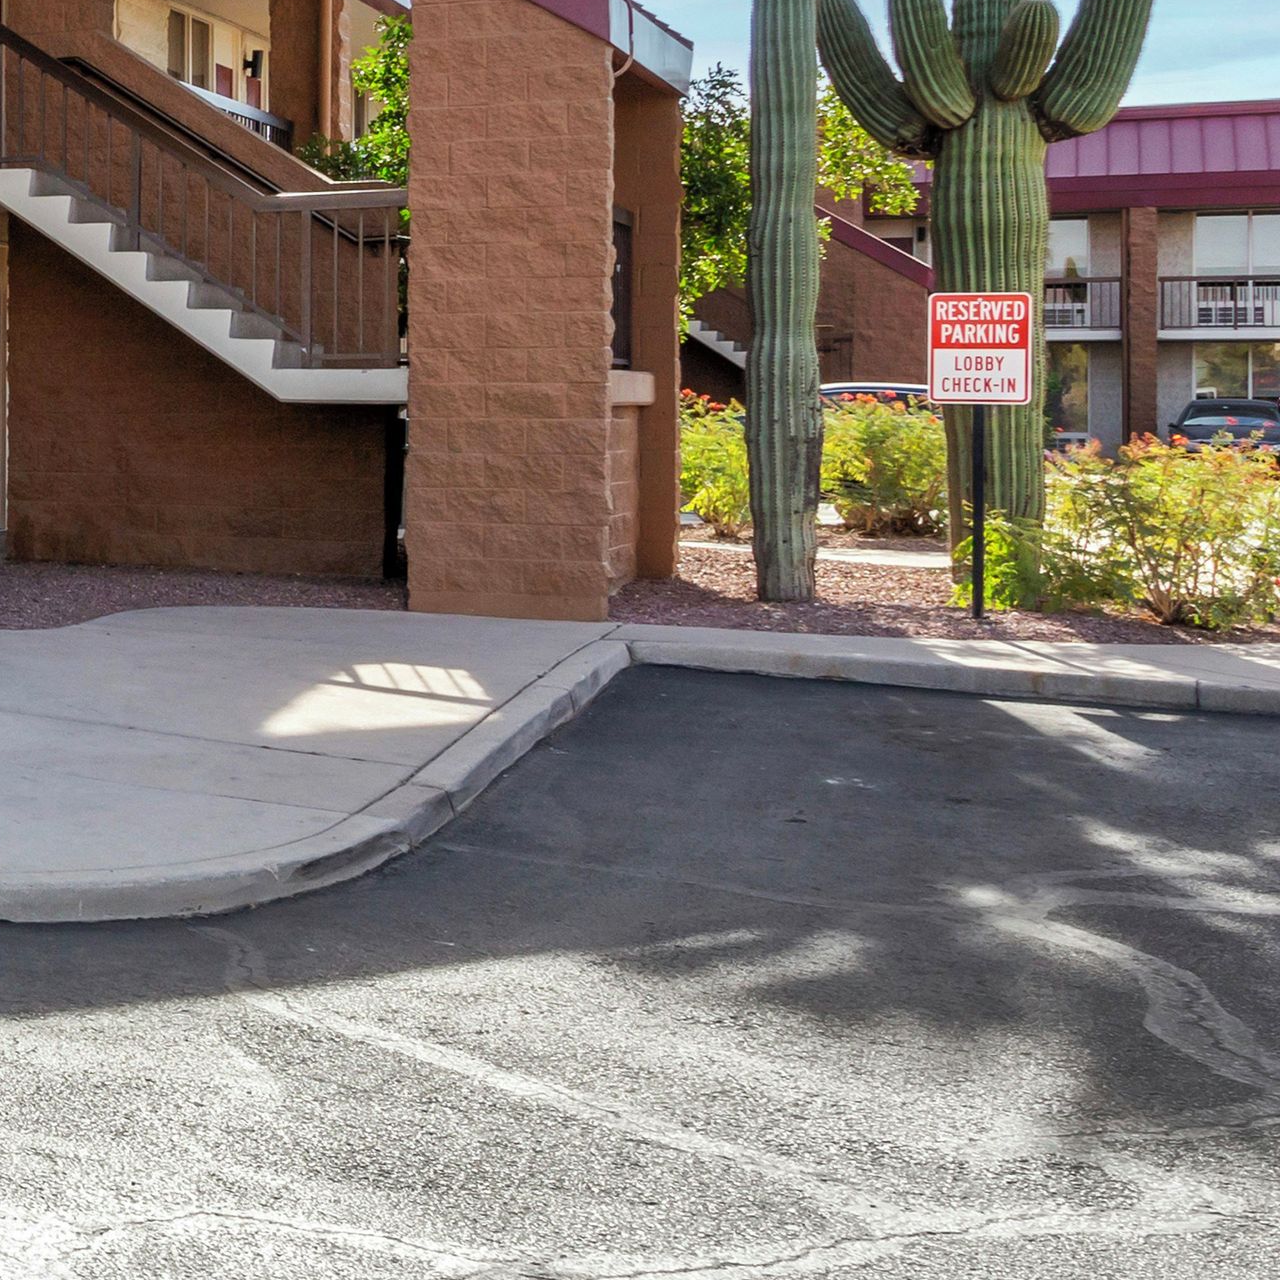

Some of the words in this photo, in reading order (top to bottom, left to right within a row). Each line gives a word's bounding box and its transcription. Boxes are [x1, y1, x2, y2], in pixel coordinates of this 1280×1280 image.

[935, 300, 1026, 321] RESERVED
[940, 323, 1020, 344] PARKING
[954, 355, 1005, 371] LOBBY
[941, 376, 1017, 393] CHECK-IN
